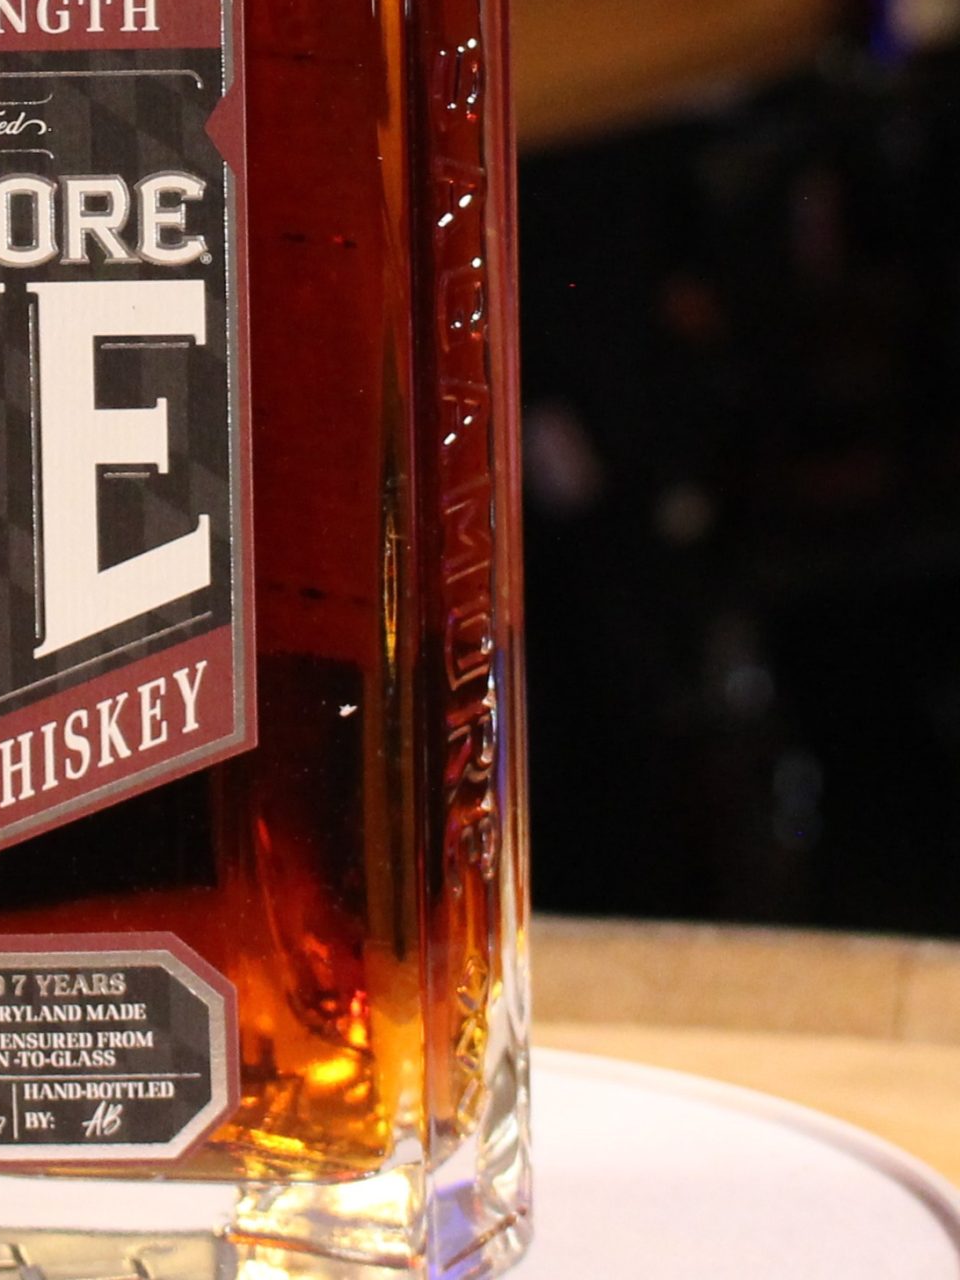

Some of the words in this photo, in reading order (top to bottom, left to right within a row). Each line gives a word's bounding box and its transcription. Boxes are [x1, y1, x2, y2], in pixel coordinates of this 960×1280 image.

[11, 975, 27, 996] 7
[35, 973, 127, 996] YEARS
[86, 1003, 147, 1021] MADE
[0, 1031, 93, 1049] ENSURED
[96, 1030, 154, 1048] FROM
[23, 1081, 175, 1100] HAND-BOTTLED
[24, 1111, 56, 1130] BY:
